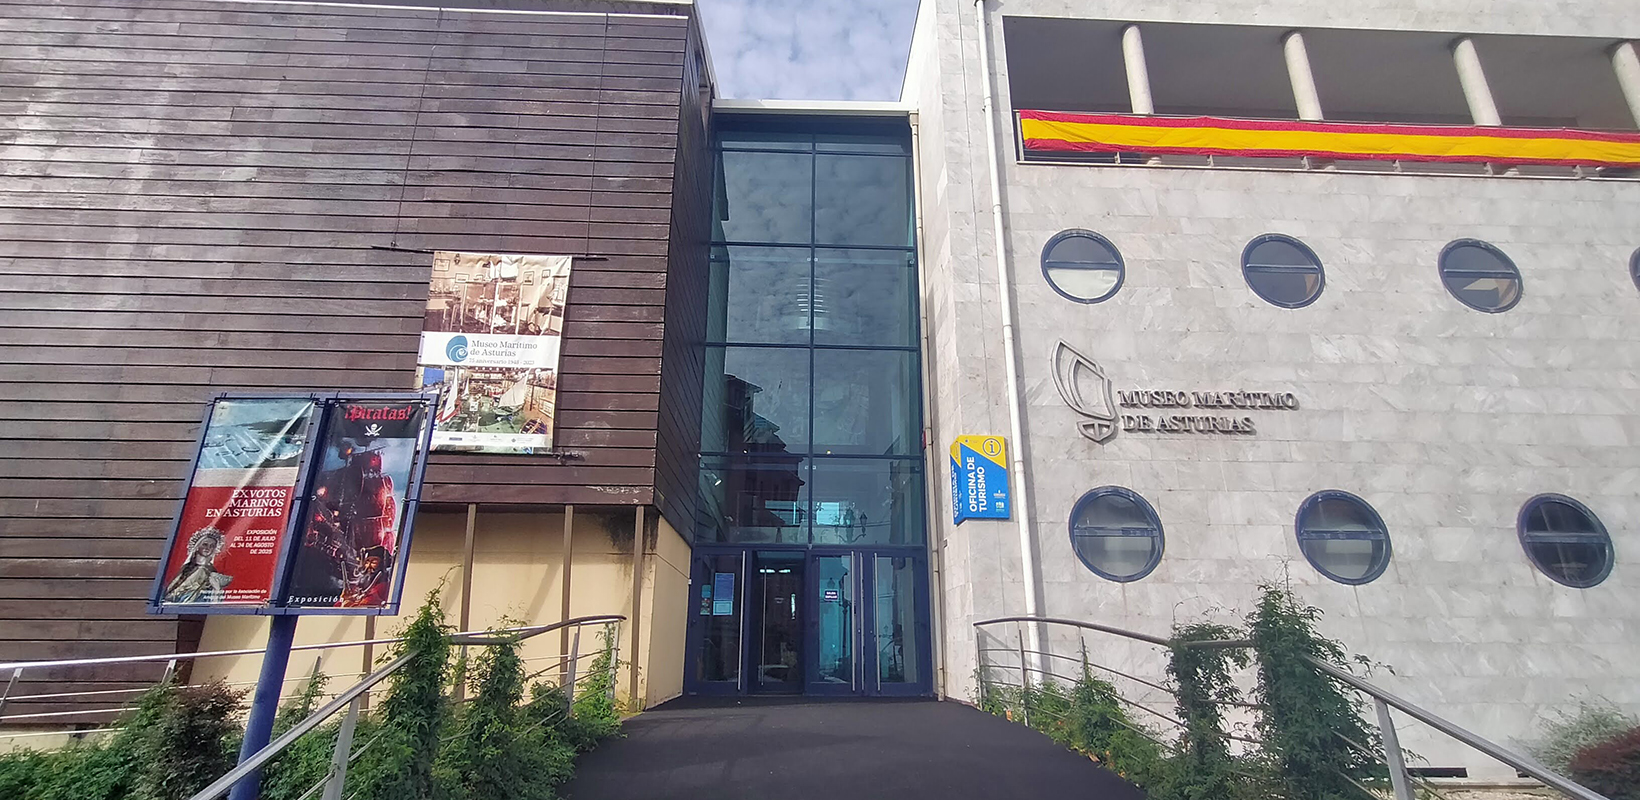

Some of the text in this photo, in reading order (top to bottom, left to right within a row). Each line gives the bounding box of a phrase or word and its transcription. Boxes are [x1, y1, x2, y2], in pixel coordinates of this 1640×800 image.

[471, 340, 538, 349] Museo Marítimo
[469, 348, 516, 357] de Asturias
[1117, 388, 1298, 409] MUSEO MARÍTIMO
[344, 405, 413, 422] ¡Piratas!
[1120, 415, 1255, 433] DE ASTURIAS
[966, 456, 978, 512] OFICINA DE
[976, 466, 988, 512] TURISMO
[229, 498, 284, 508] MARINOS
[205, 508, 282, 518] EN ASTURIAS
[289, 595, 345, 604] Exposición
